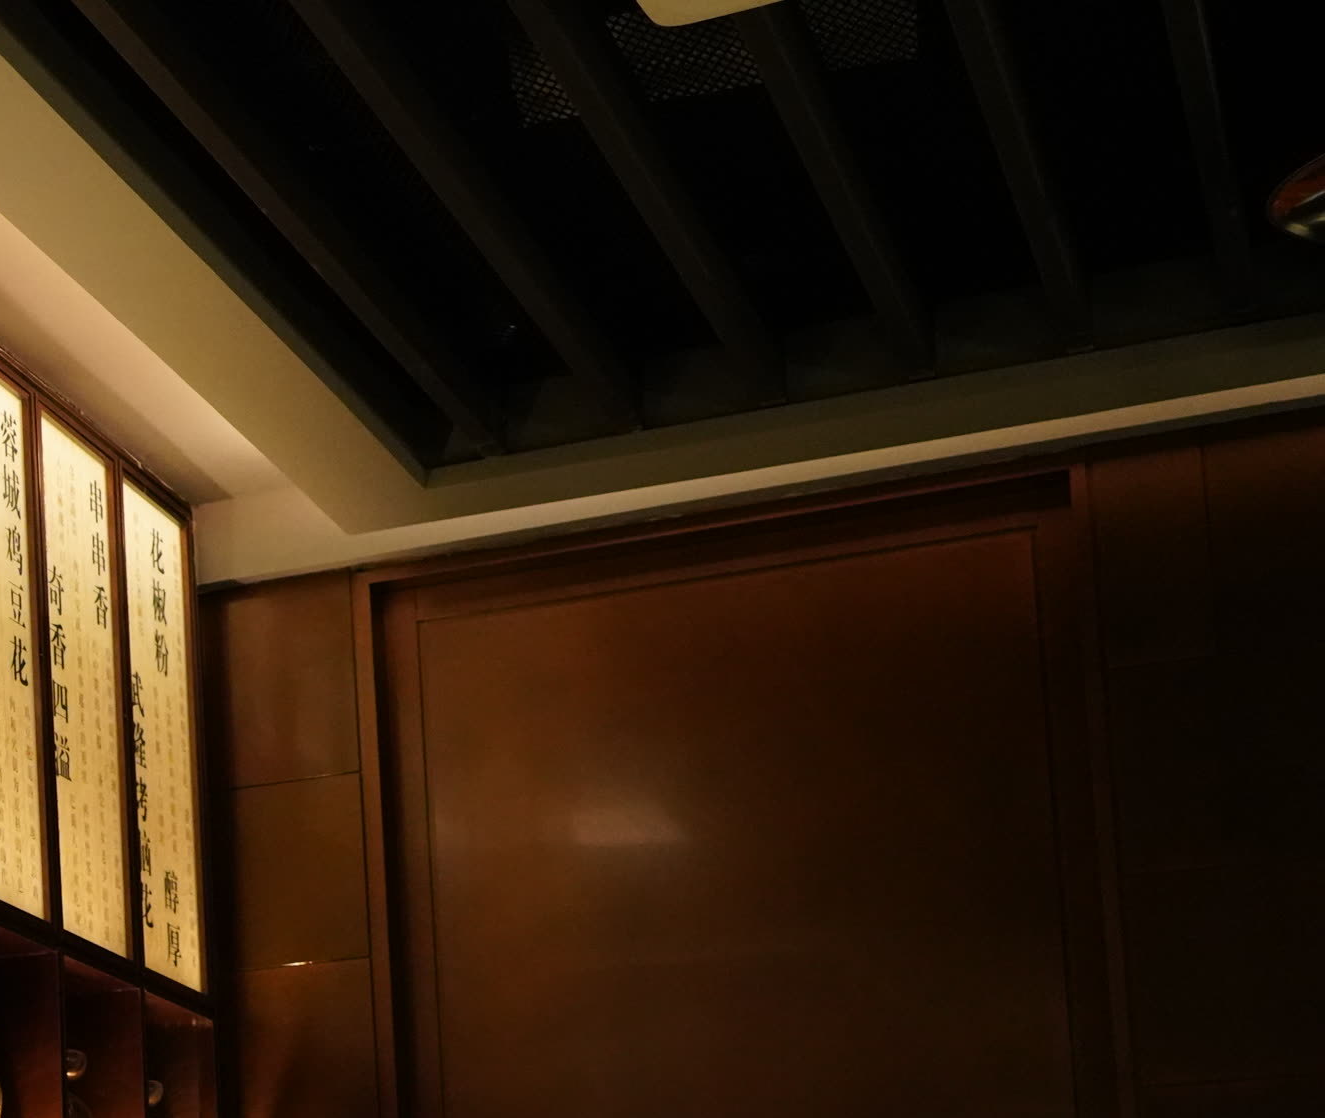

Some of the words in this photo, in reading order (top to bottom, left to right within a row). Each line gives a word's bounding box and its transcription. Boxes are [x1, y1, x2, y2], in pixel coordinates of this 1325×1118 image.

[1, 410, 29, 686] 蓉城鸡豆花
[89, 480, 109, 629] 串串香
[150, 528, 169, 677] 花椒粉
